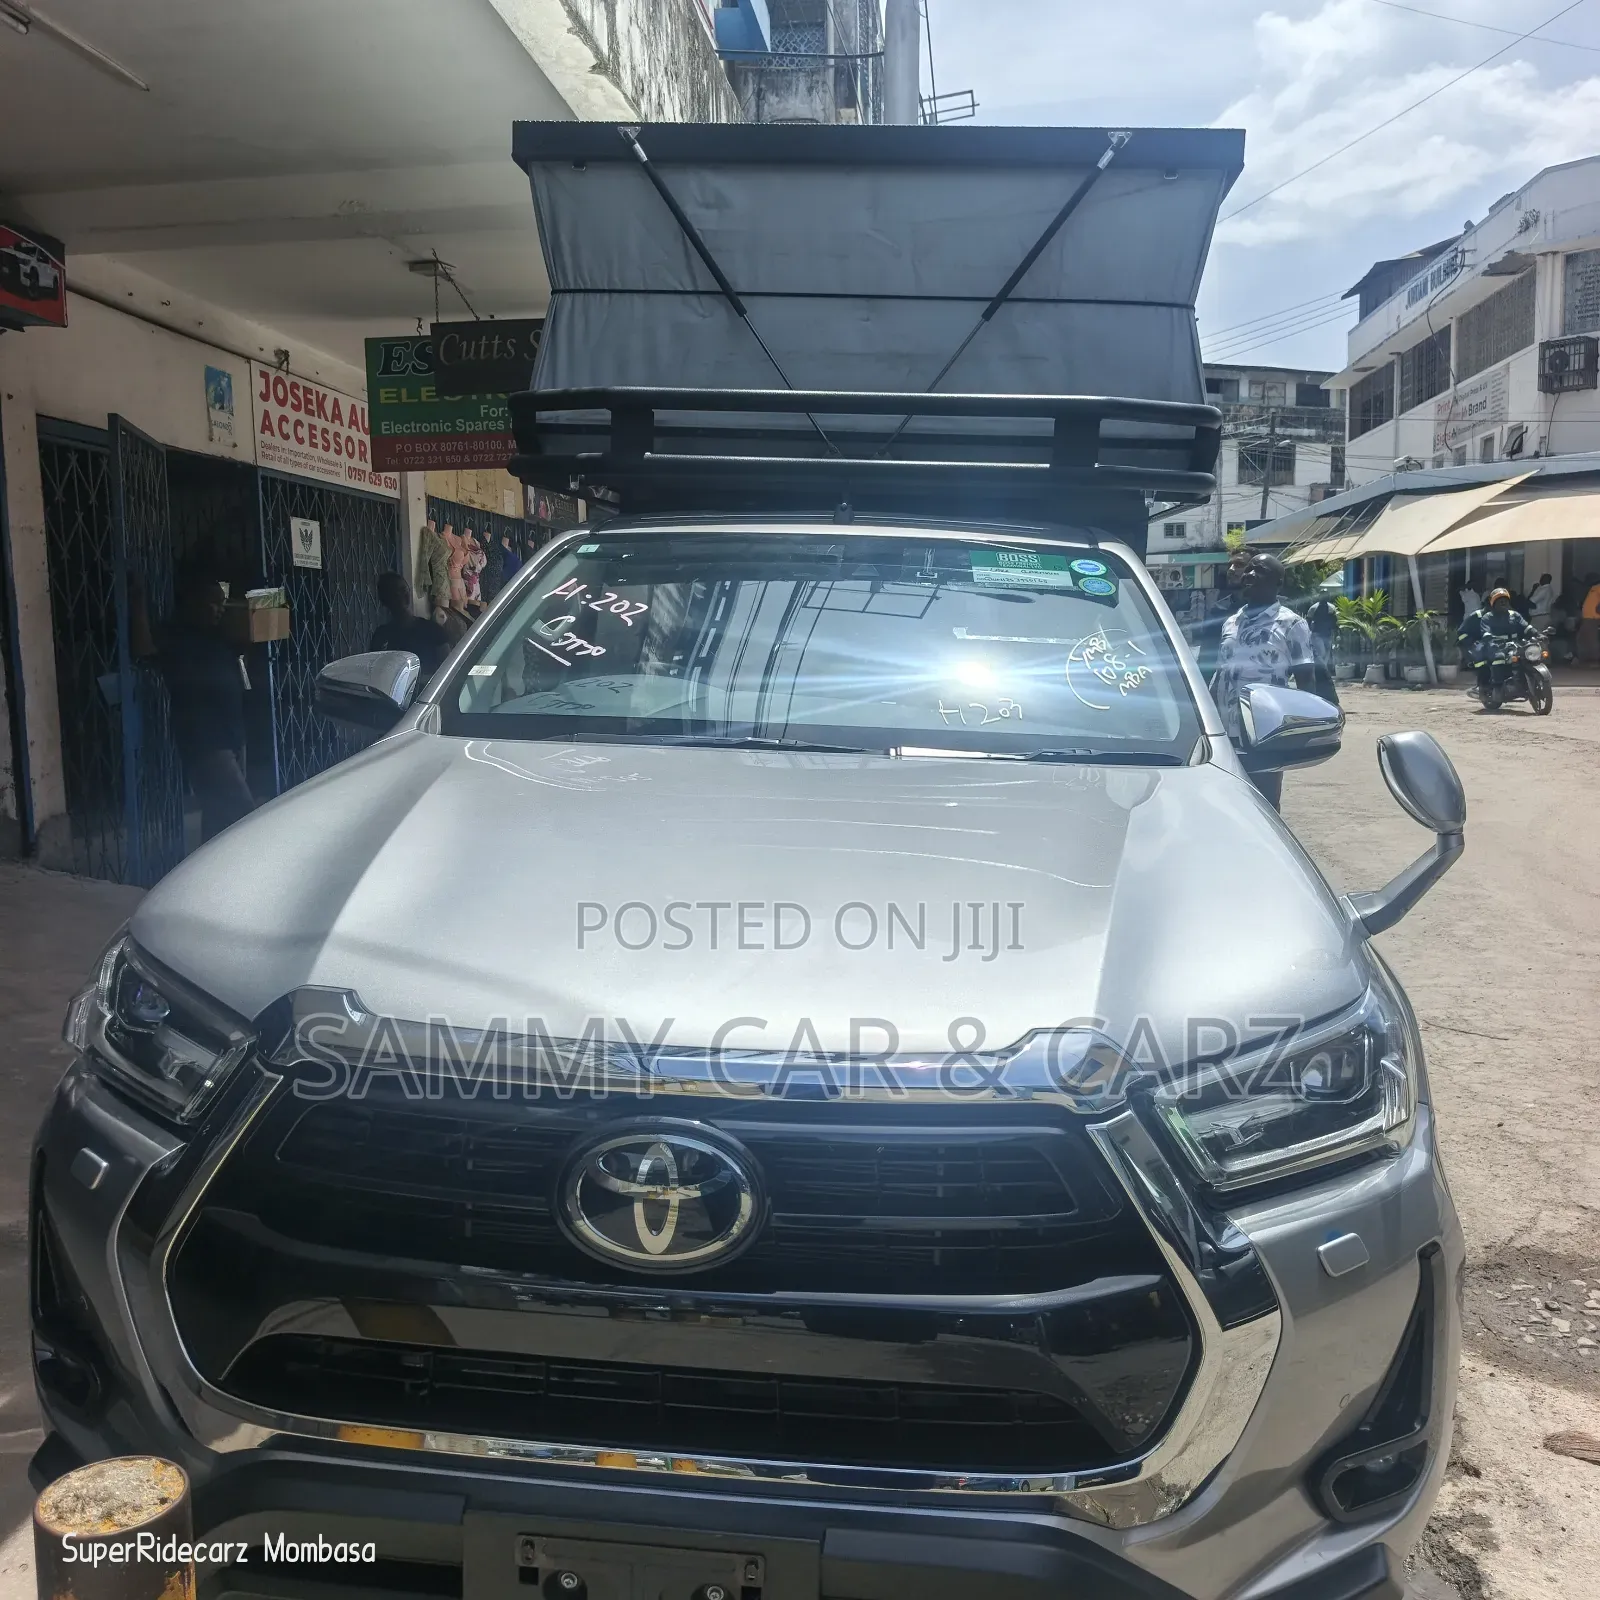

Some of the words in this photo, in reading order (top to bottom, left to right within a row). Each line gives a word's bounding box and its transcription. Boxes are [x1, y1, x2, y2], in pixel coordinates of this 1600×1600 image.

[440, 333, 516, 366] Cutts
[259, 370, 344, 427] JOSEKA
[1468, 396, 1487, 416] Brand
[480, 405, 508, 417] For:
[1437, 400, 1451, 415] Print
[381, 419, 452, 434] Electronic
[456, 418, 505, 433] Spares
[260, 409, 368, 463] ACCESSOR
[261, 441, 280, 453] Dealers
[317, 455, 339, 468] Wholesale
[416, 442, 437, 452] BOX
[261, 450, 276, 462] Retail
[404, 456, 424, 464] 0722
[427, 455, 442, 463] 321
[464, 454, 471, 462] &
[473, 454, 494, 462] 0722
[348, 466, 366, 482] 0757
[369, 472, 382, 486] 629
[998, 553, 1039, 562] BOSS
